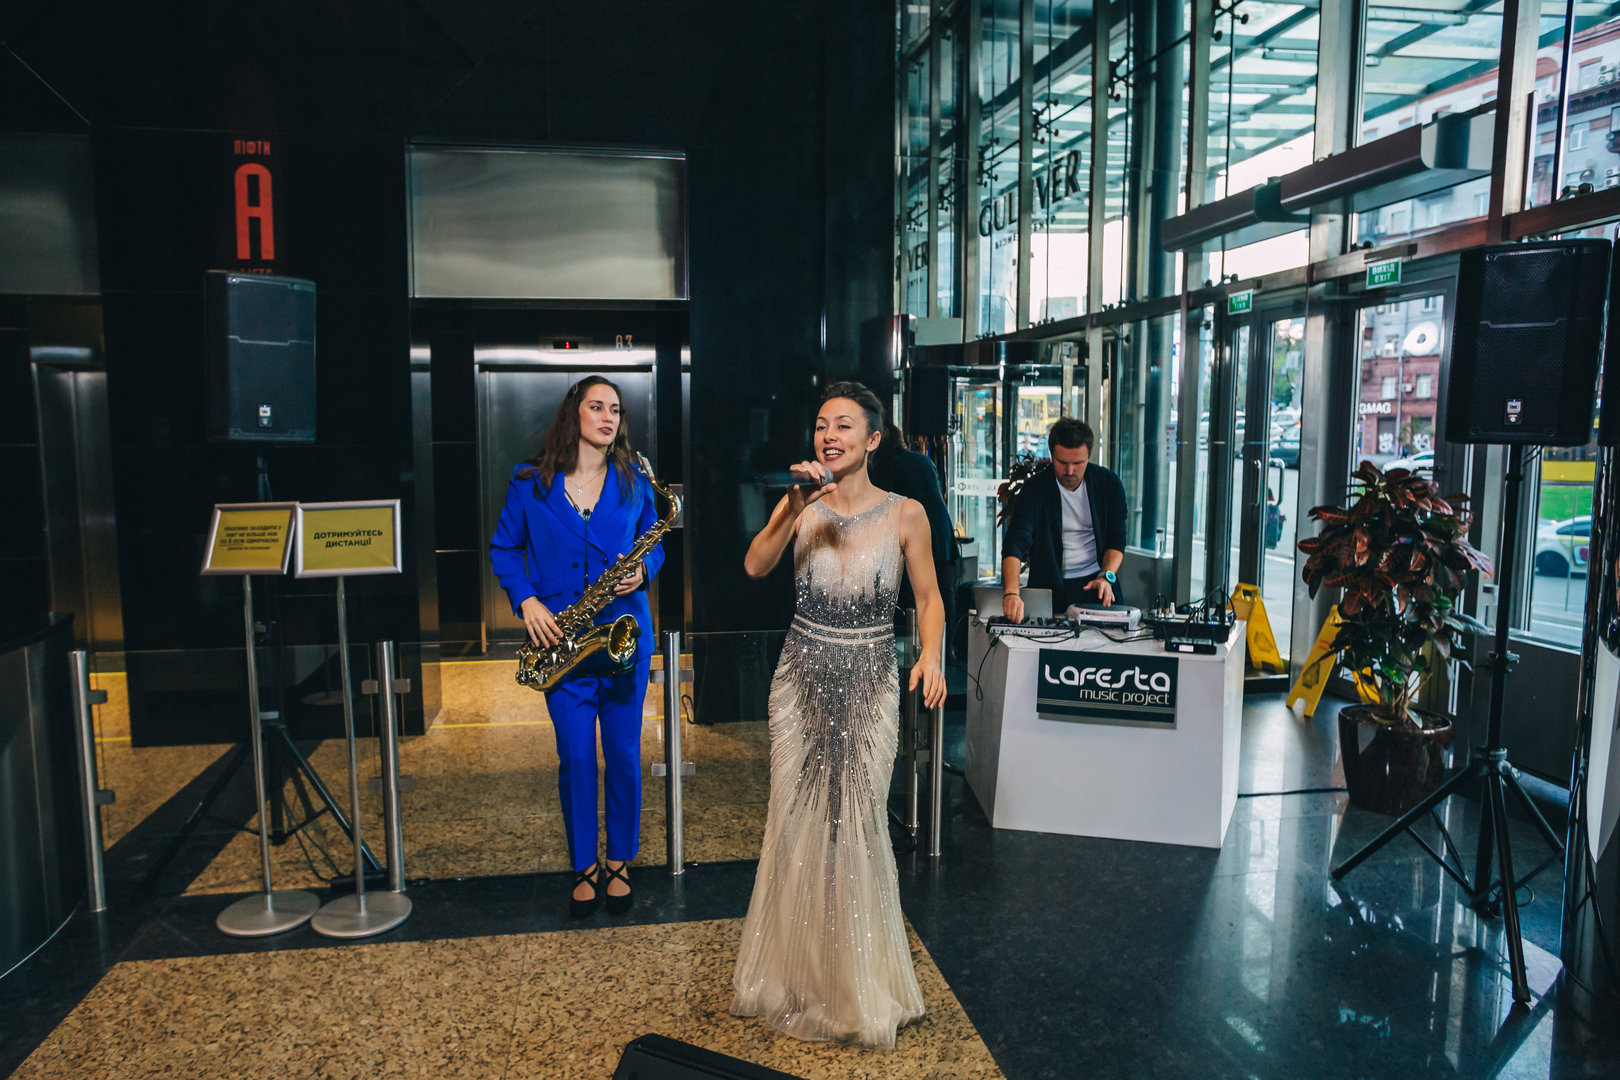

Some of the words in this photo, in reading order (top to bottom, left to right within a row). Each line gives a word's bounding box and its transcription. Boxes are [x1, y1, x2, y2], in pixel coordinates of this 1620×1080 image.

[978, 150, 1082, 237] GULVER
[1374, 273, 1391, 283] EXIT
[313, 529, 383, 540] ДОТРИМУЙТЕСЬ
[325, 538, 372, 548] ДИСТАНЦІЇ
[1079, 689, 1119, 701] music
[1122, 691, 1169, 706] project
